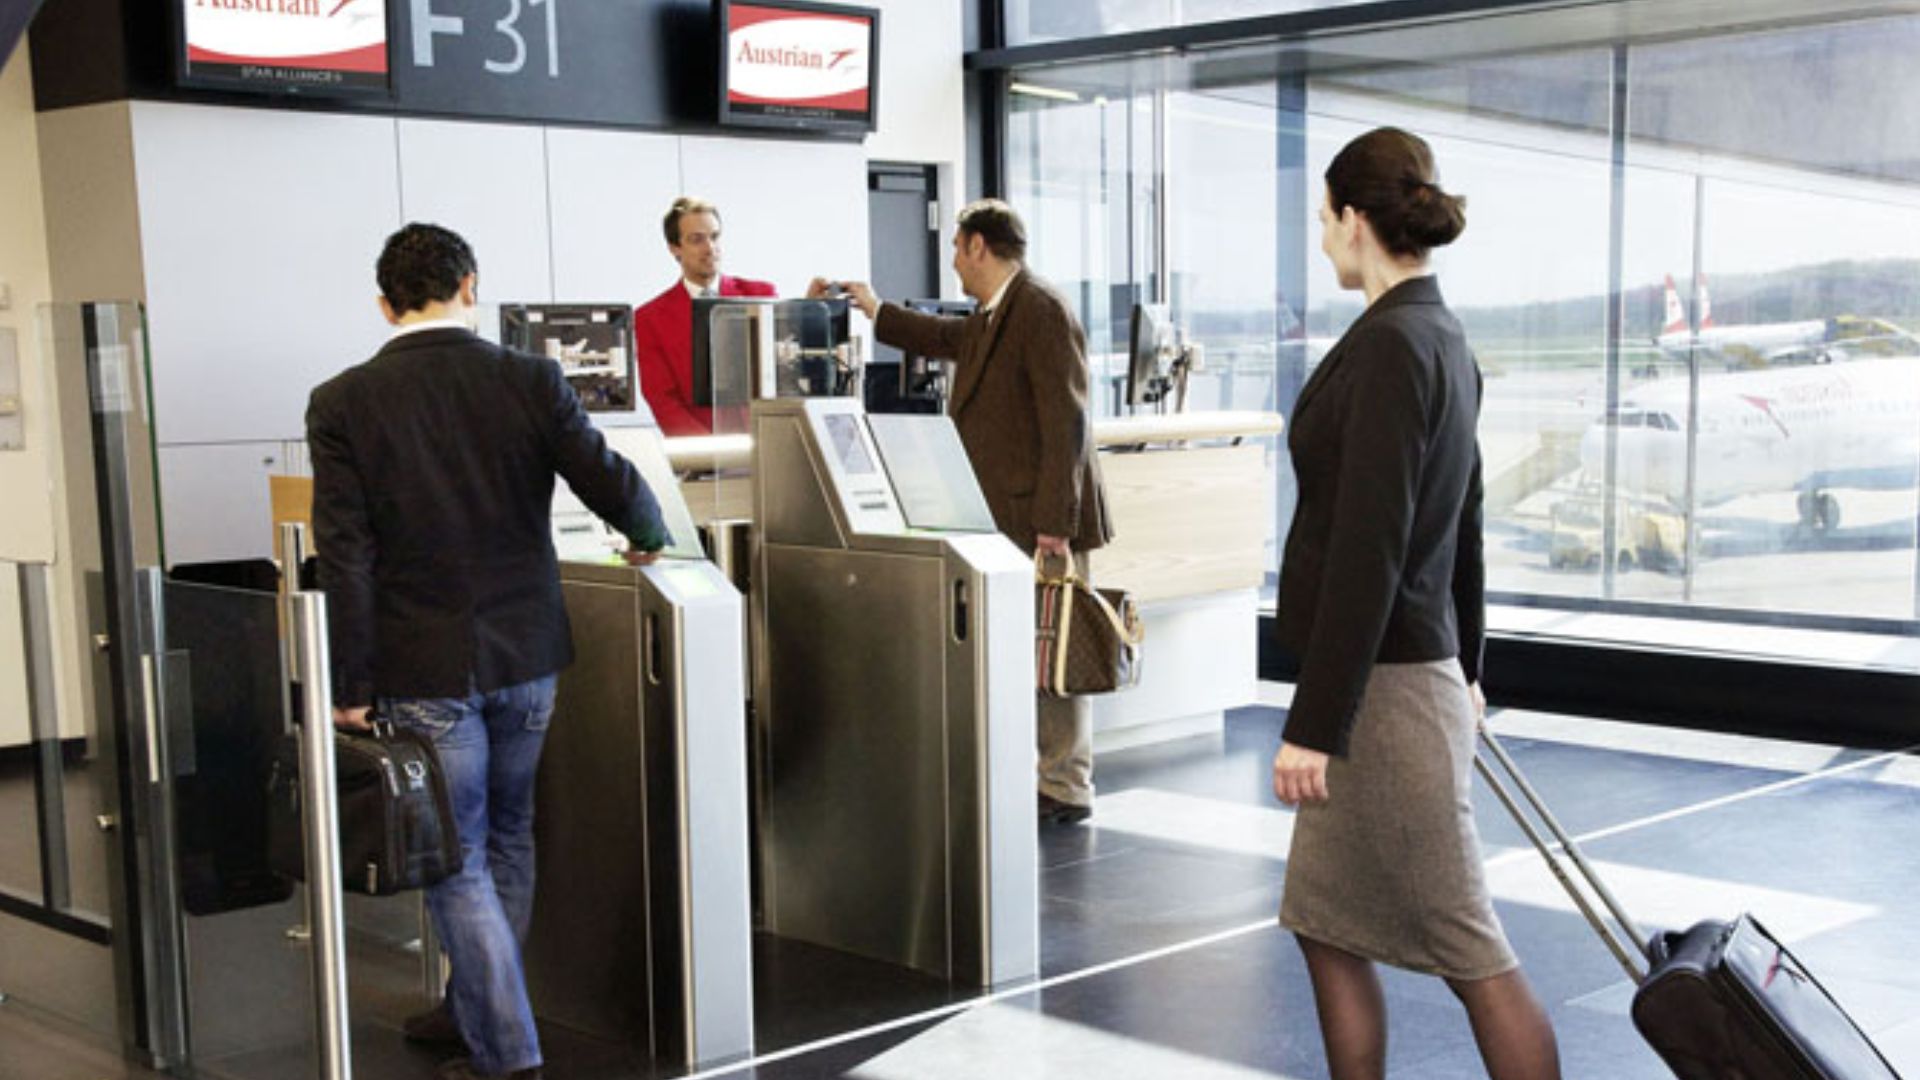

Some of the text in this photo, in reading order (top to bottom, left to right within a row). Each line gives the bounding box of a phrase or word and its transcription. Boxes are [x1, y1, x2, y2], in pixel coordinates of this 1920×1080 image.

[194, 0, 319, 16] ustrian
[410, 0, 559, 77] F 31
[737, 39, 823, 69] Austrian
